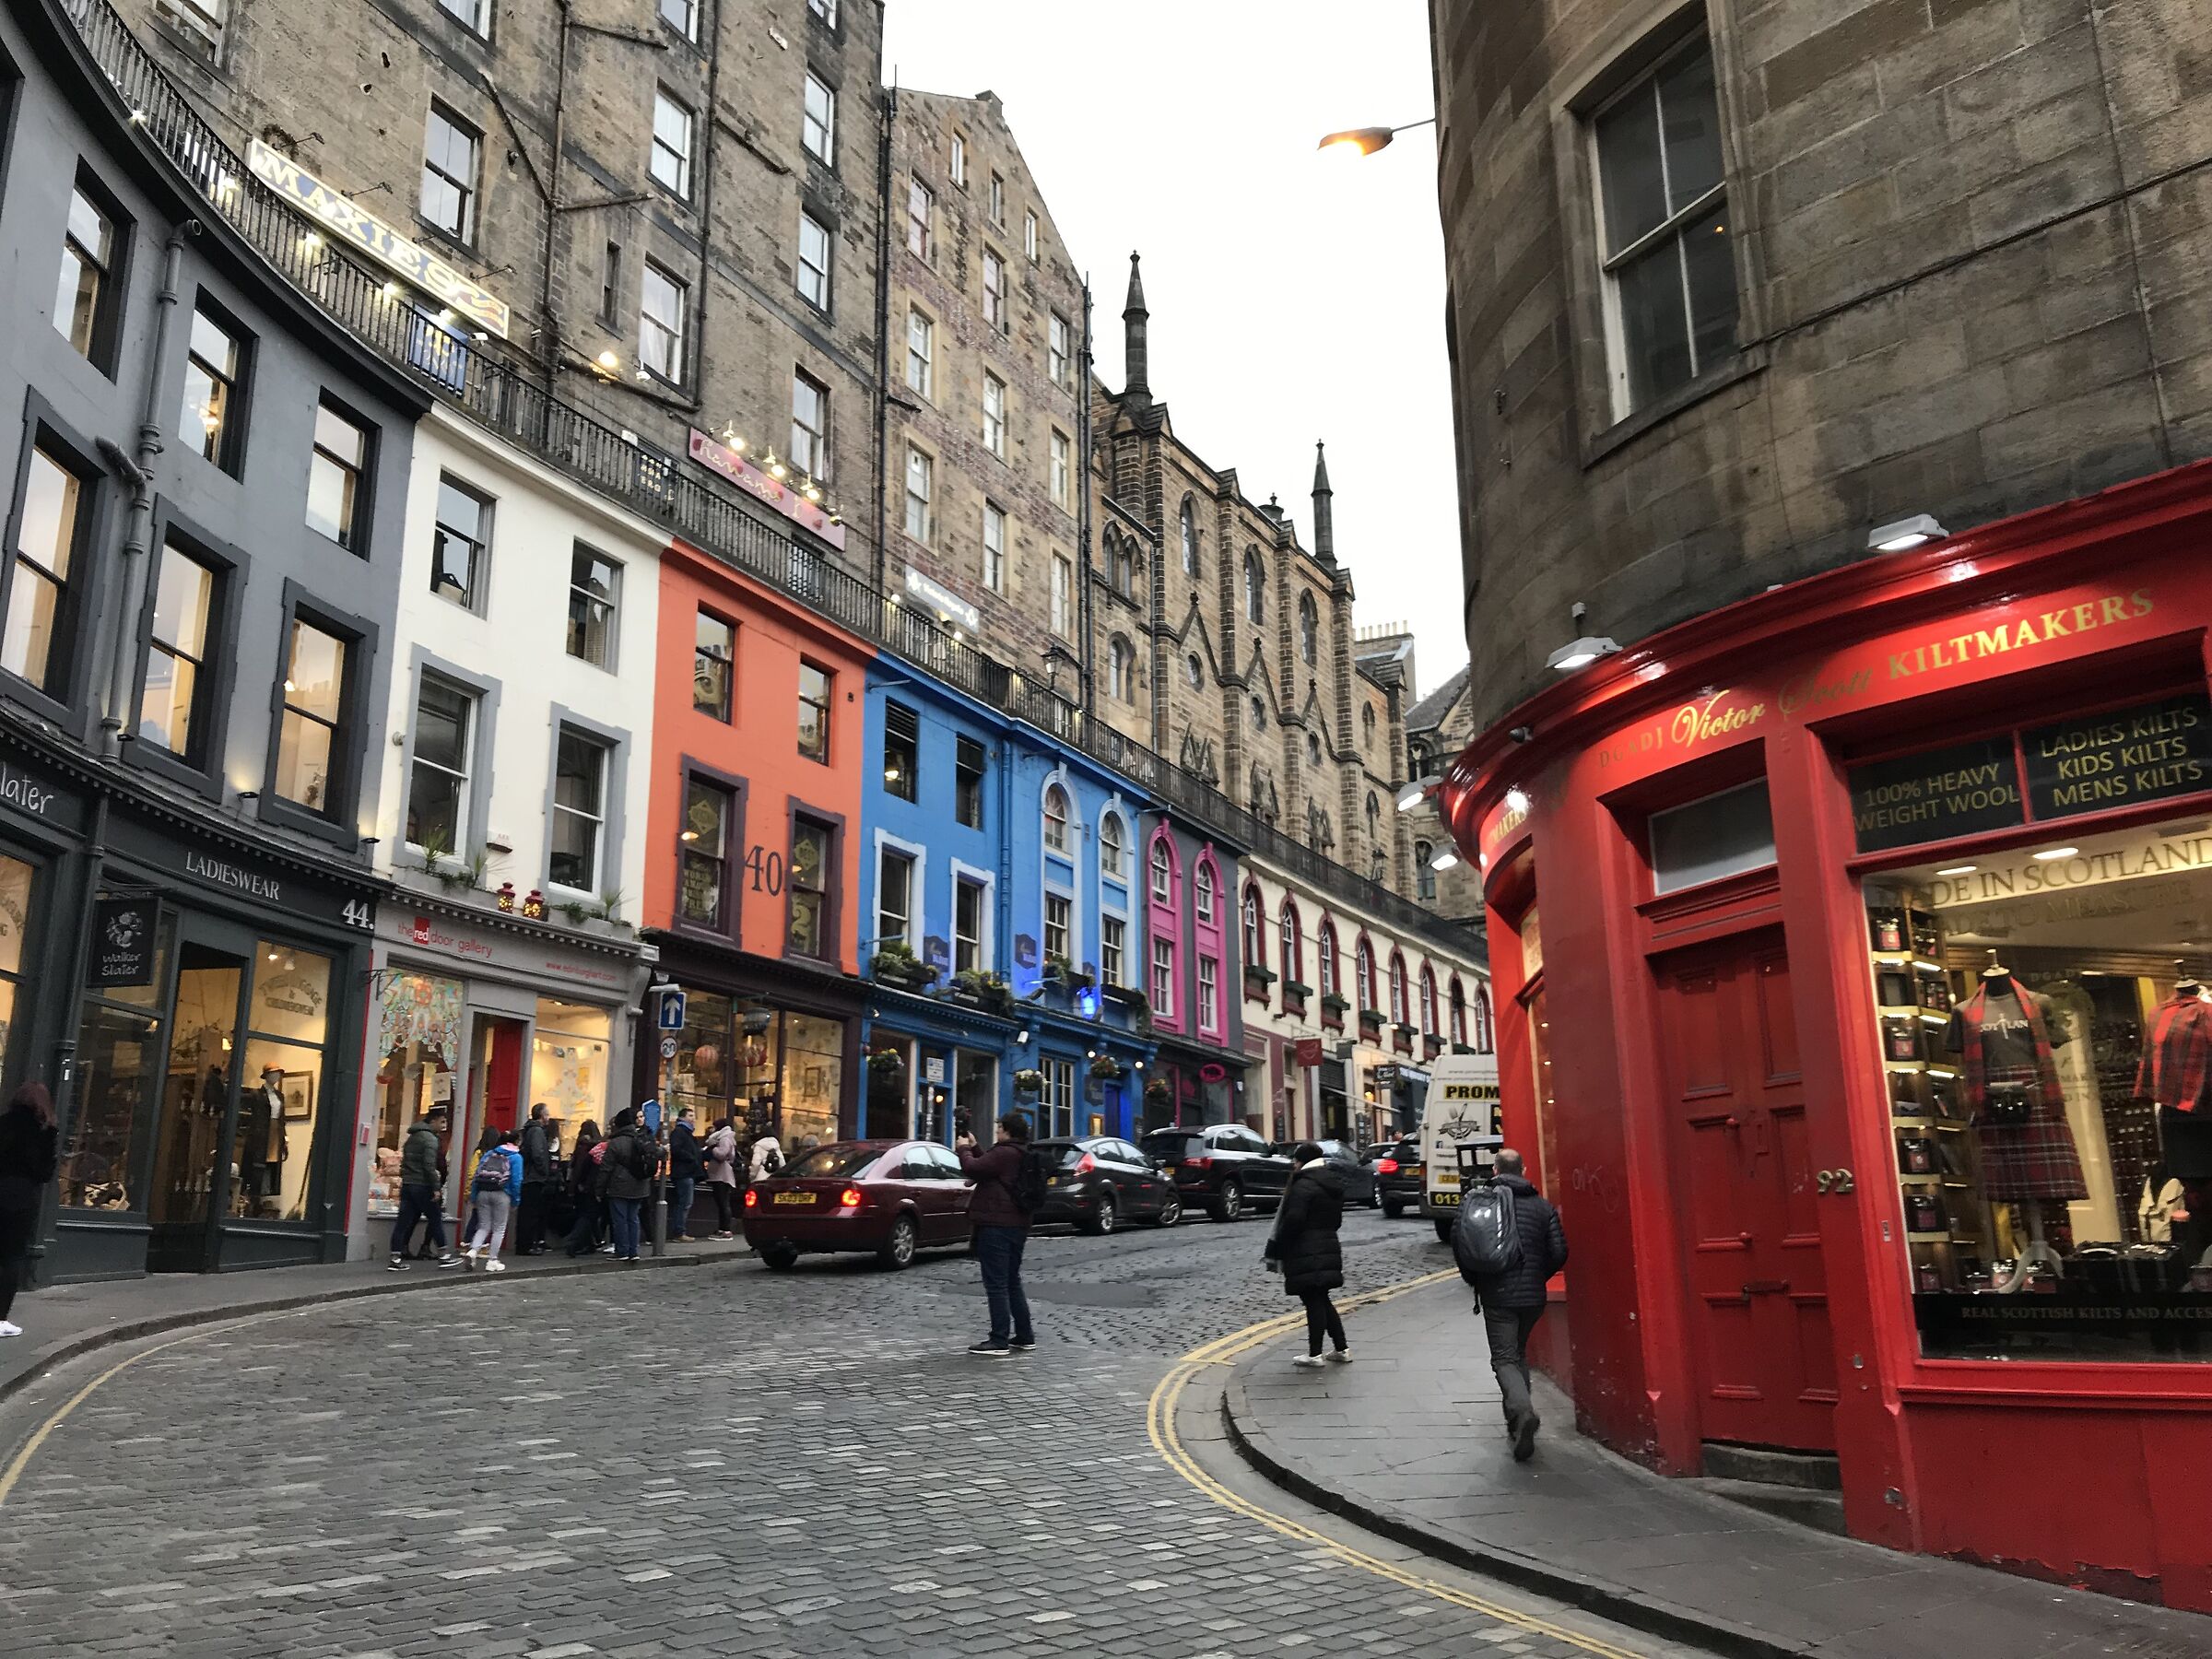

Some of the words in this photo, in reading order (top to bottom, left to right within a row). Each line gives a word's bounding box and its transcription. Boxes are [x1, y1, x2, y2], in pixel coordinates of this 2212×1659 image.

[1671, 690, 1766, 747] Victor
[1778, 662, 1873, 723] Scott
[1888, 587, 2155, 680] KILTMAKERS
[2041, 723, 2124, 759] LADIES
[2133, 707, 2198, 737] KILTS
[2057, 751, 2114, 781] KIDS
[2121, 736, 2188, 768] KILTS
[1865, 781, 1921, 808] 100%
[1927, 763, 2000, 795] HEAVY
[2053, 775, 2128, 808] MENS
[2136, 760, 2204, 793] KILTS
[1856, 798, 1940, 832] WEIGHT
[1947, 786, 2020, 815] WOOL
[185, 851, 279, 900] LADIESWEAR
[745, 844, 782, 897] 40
[1980, 868, 2015, 899] IN
[2023, 836, 2212, 892] SCOTLAND
[102, 951, 142, 964] walker
[397, 922, 414, 938] the
[414, 927, 429, 941] red
[430, 928, 454, 947] door
[457, 938, 492, 959] gallery
[1817, 1170, 1854, 1194] 92
[1961, 1307, 1998, 1319] REAL
[2000, 1307, 2073, 1319] SCOTTISH
[2078, 1307, 2122, 1319] KILTS
[2125, 1307, 2159, 1319] AND
